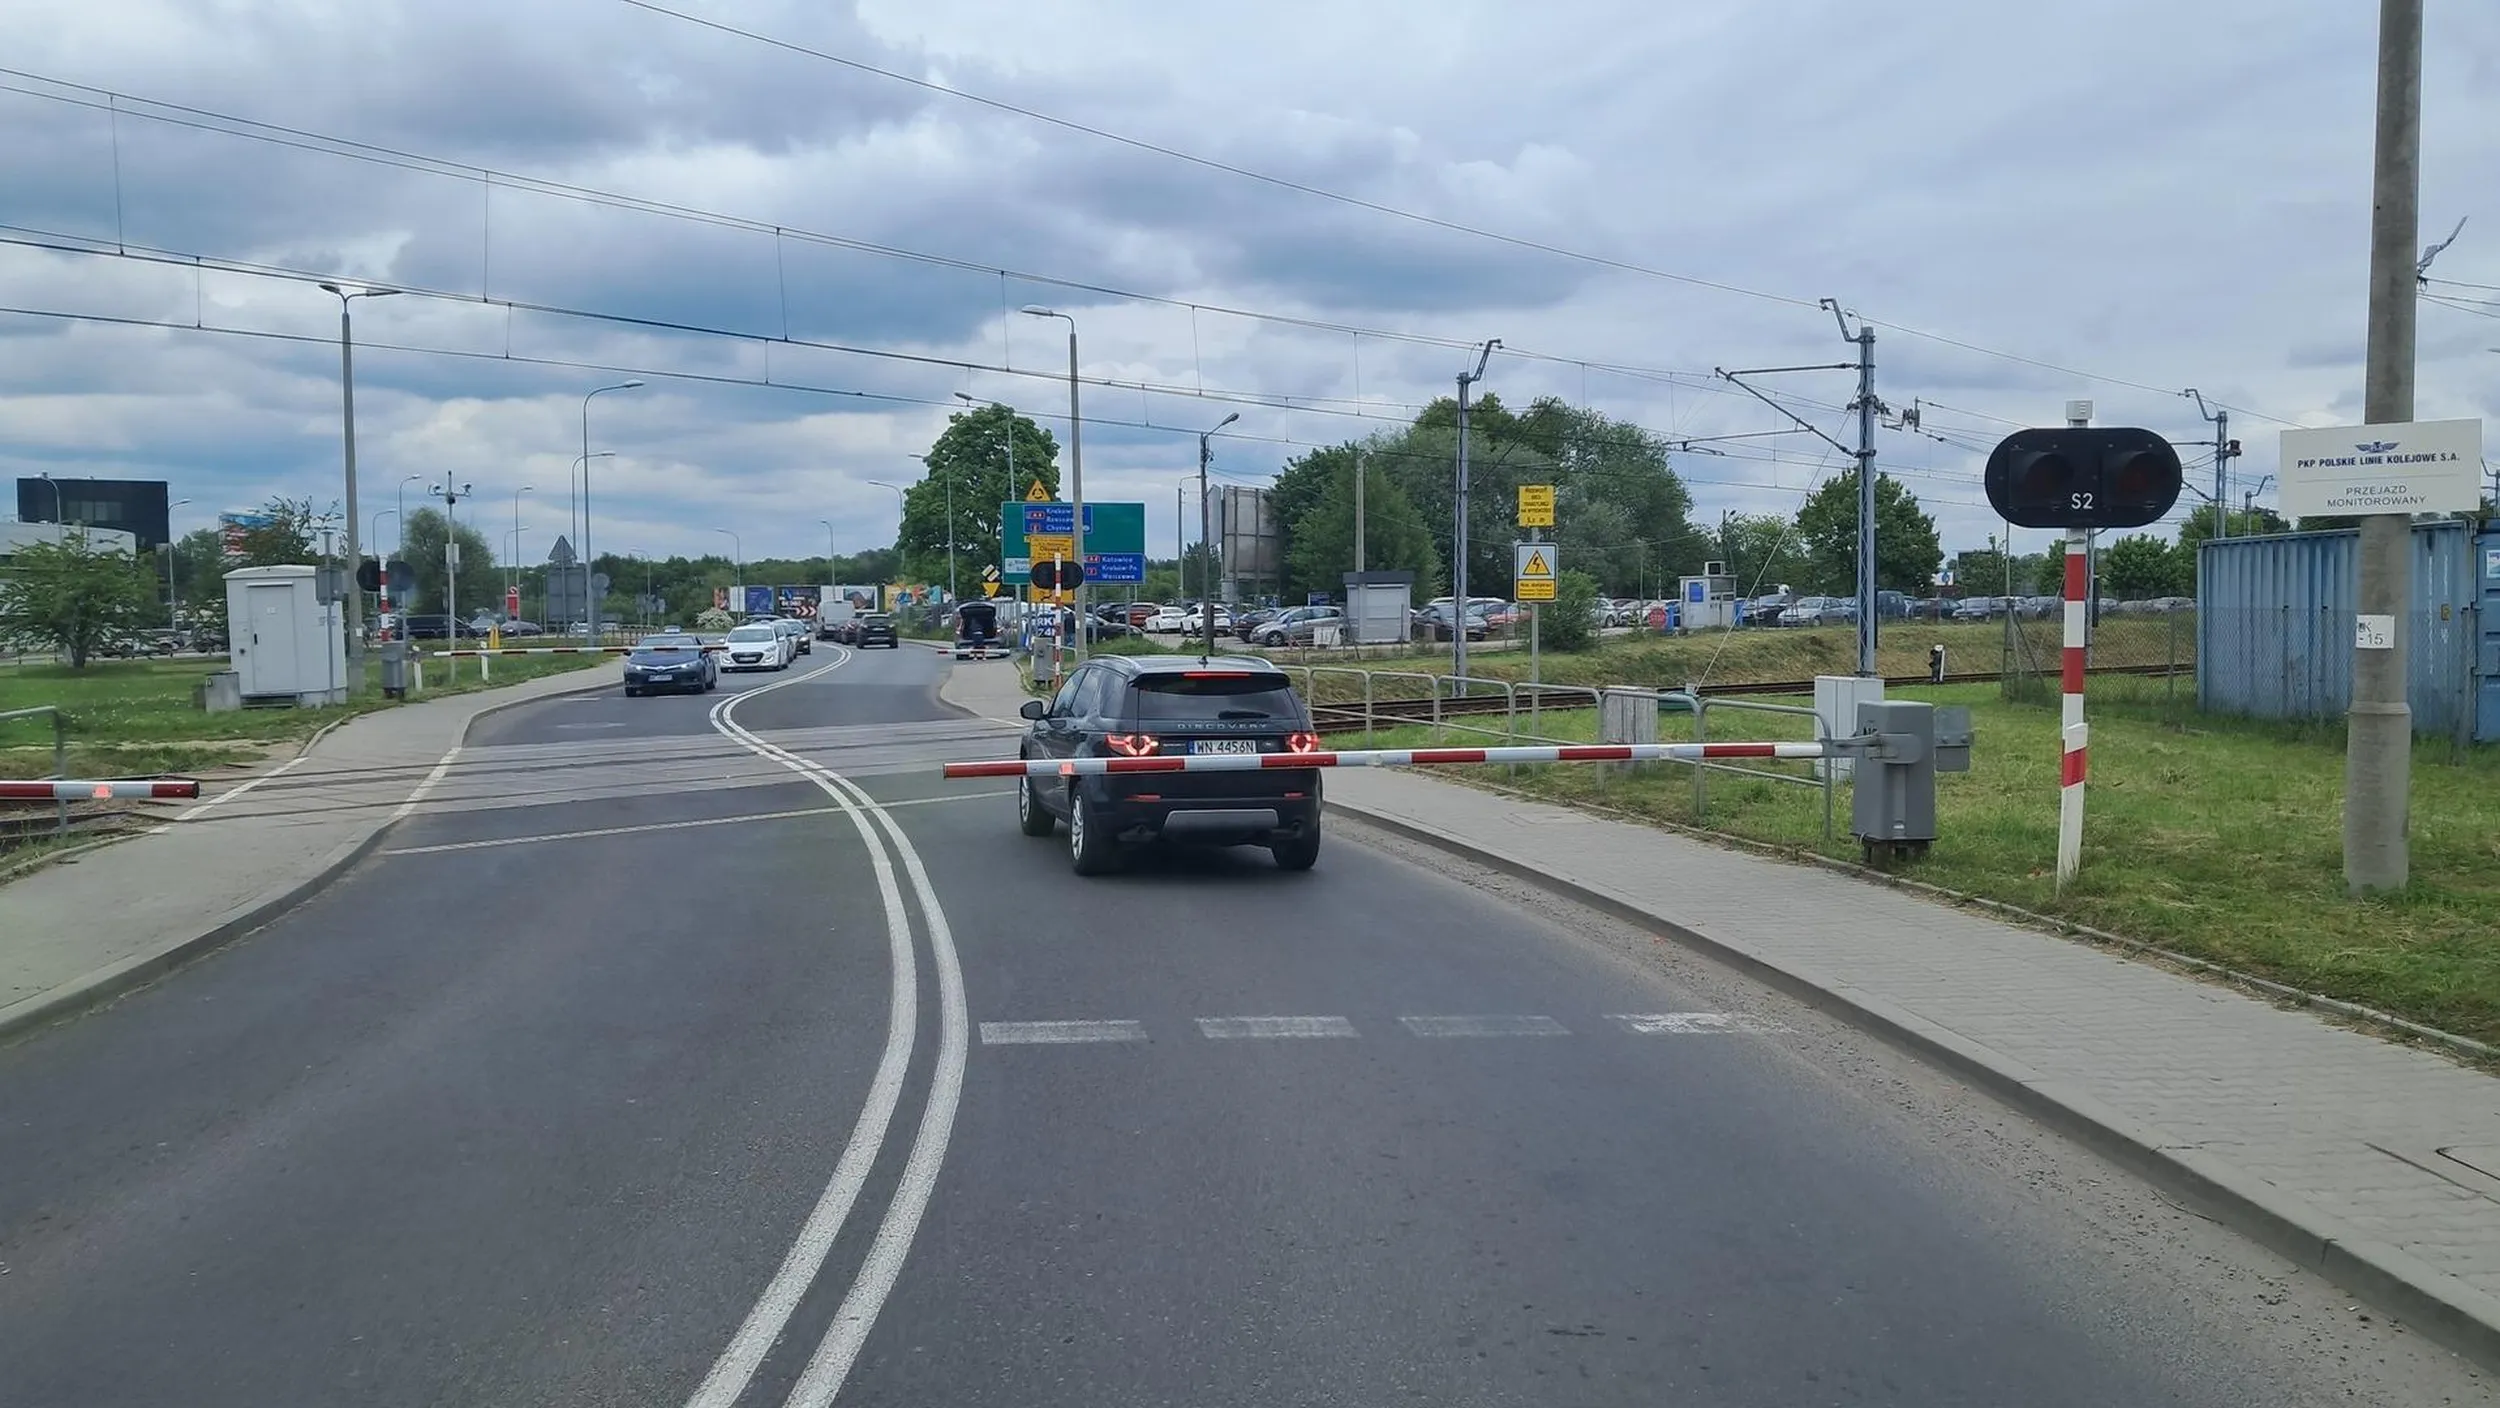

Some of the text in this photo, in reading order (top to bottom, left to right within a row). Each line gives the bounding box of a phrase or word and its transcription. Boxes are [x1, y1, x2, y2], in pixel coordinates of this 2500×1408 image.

[2297, 452, 2460, 468] PKP POLSKIE LINIE KOLEJOWE S.A.
[2346, 484, 2407, 496] PRZEJAZD
[2071, 492, 2093, 509] S2
[2327, 495, 2427, 508] MONITOROWANY
[1177, 722, 1267, 730] DISCOVERY
[1196, 741, 1213, 753] WN
[1217, 741, 1254, 753] 4456N
